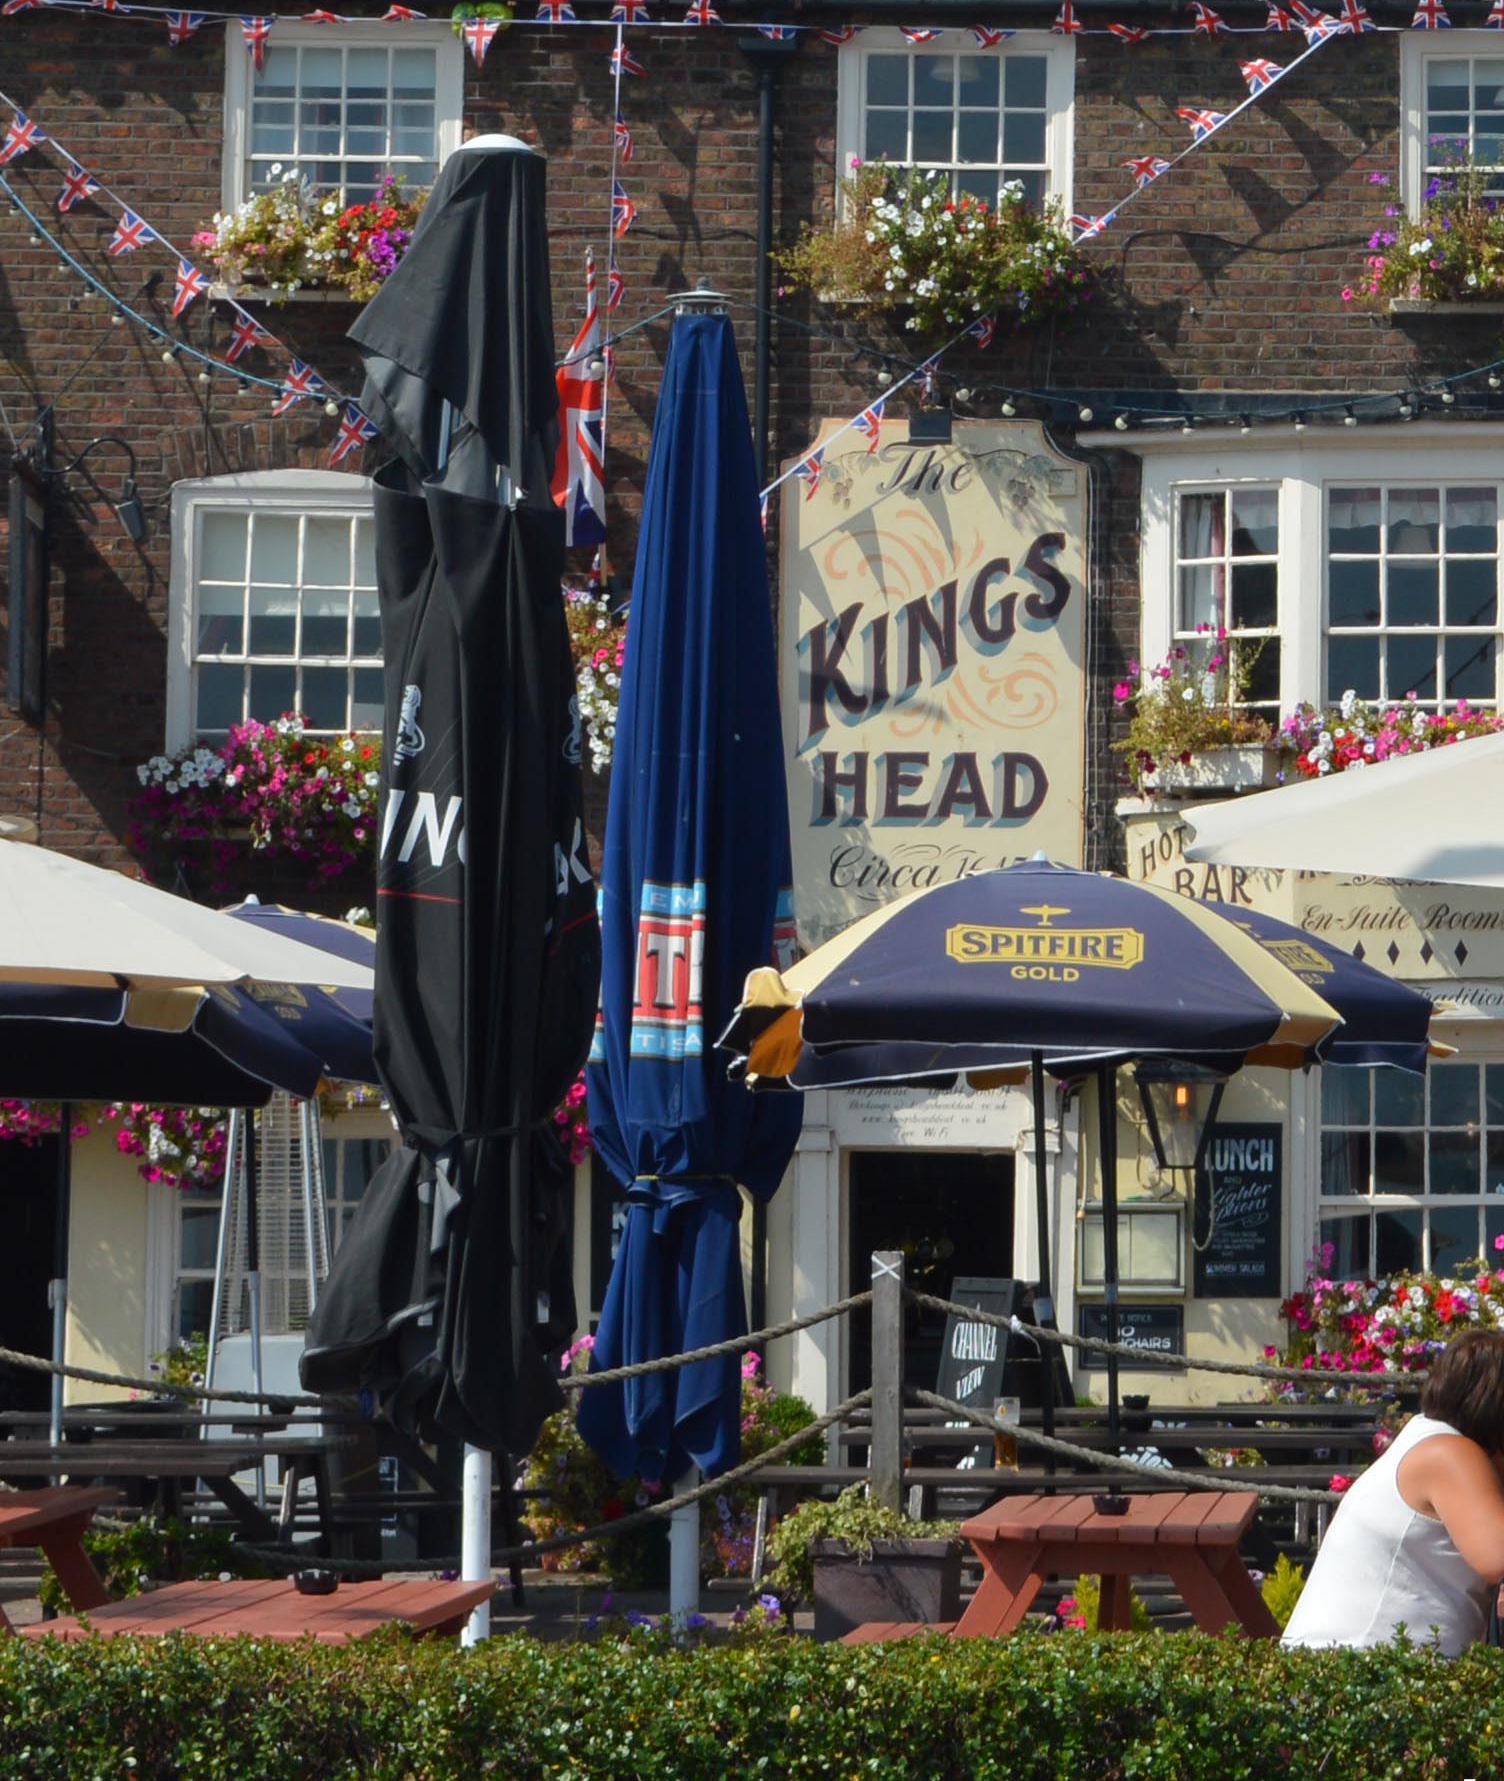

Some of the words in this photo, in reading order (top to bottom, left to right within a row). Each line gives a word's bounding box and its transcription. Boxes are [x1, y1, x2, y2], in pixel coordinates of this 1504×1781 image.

[877, 440, 975, 496] The
[799, 532, 1072, 744] KINGS
[810, 751, 1049, 826] HEAD
[829, 844, 942, 890] Circa
[1140, 824, 1187, 880] HOT
[1174, 863, 1253, 904] BAR
[961, 931, 1125, 960] SPITFIRE
[1010, 965, 1080, 982] GOLD
[951, 1321, 998, 1362] CHANNEL
[955, 1365, 986, 1401] VIEW
